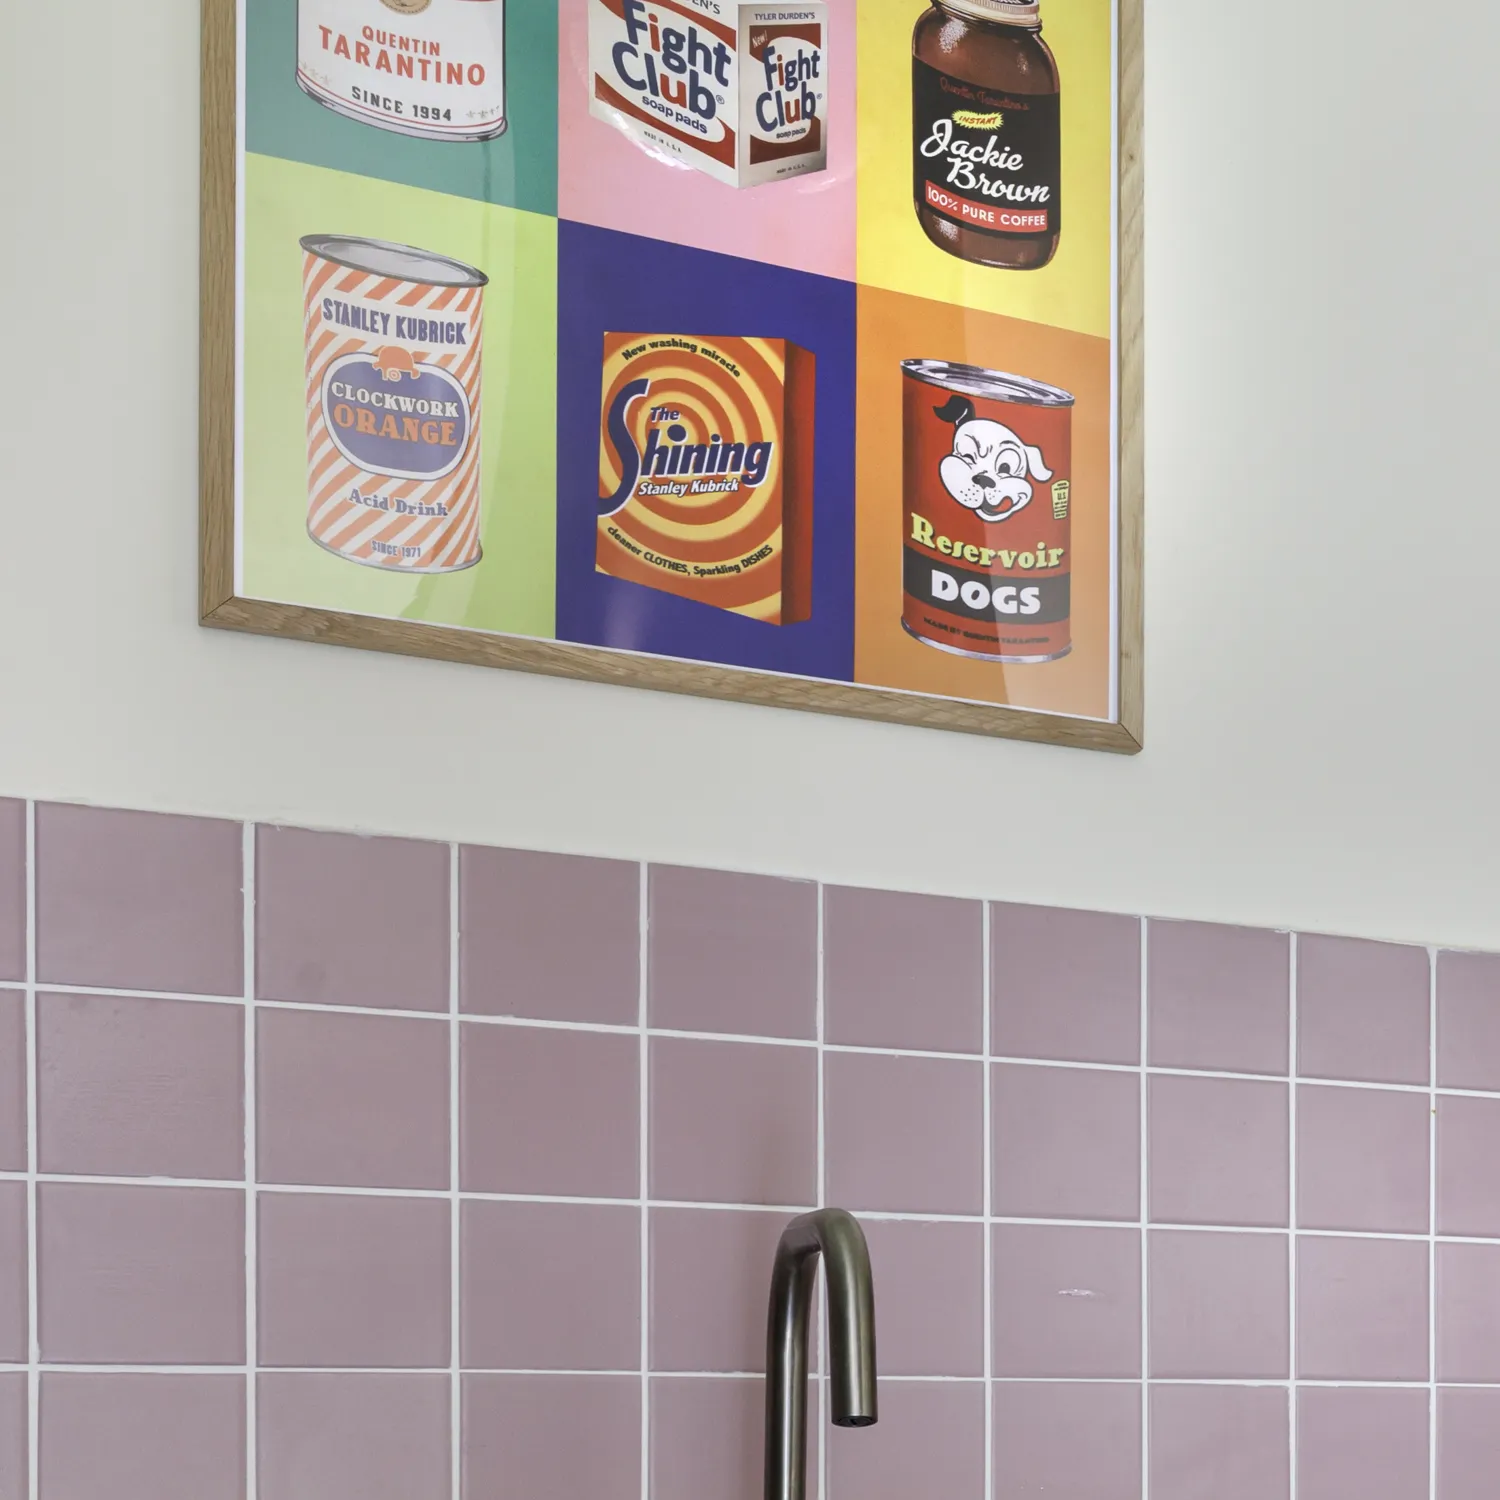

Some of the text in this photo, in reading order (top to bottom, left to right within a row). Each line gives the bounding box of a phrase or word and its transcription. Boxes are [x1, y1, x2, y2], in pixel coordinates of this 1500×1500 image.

[754, 12, 816, 21] TYLER DURDEN'S
[318, 24, 486, 86] TARANTINO
[361, 25, 441, 57] QUENTIN
[622, 0, 732, 87] Fight
[751, 30, 768, 49] New!
[612, 41, 717, 120] Club
[762, 46, 821, 91] Fight
[351, 86, 452, 122] SINCE 1994
[641, 96, 708, 134] soap pads
[755, 81, 816, 132] Club
[959, 115, 999, 125] INSTANT
[919, 119, 1024, 171] Jackie
[946, 156, 1050, 203] Brown
[927, 186, 1045, 227] 100% PURE COFFEE
[322, 298, 467, 345] STANLEY KUBRICK
[621, 338, 741, 378] New washing miracle
[331, 381, 460, 418] CLOCKWORK
[650, 406, 680, 422] The
[333, 403, 458, 446] ORANGE
[597, 378, 774, 517] Shining
[349, 488, 449, 517] Acid Drink
[638, 479, 739, 497] Stanley Kubrick
[371, 540, 421, 558] SINCE 1971
[607, 526, 773, 577] cleaner CLOTHES, Sparkling DISHES
[911, 512, 1065, 569] Reservoir
[932, 569, 1041, 615] DOGS
